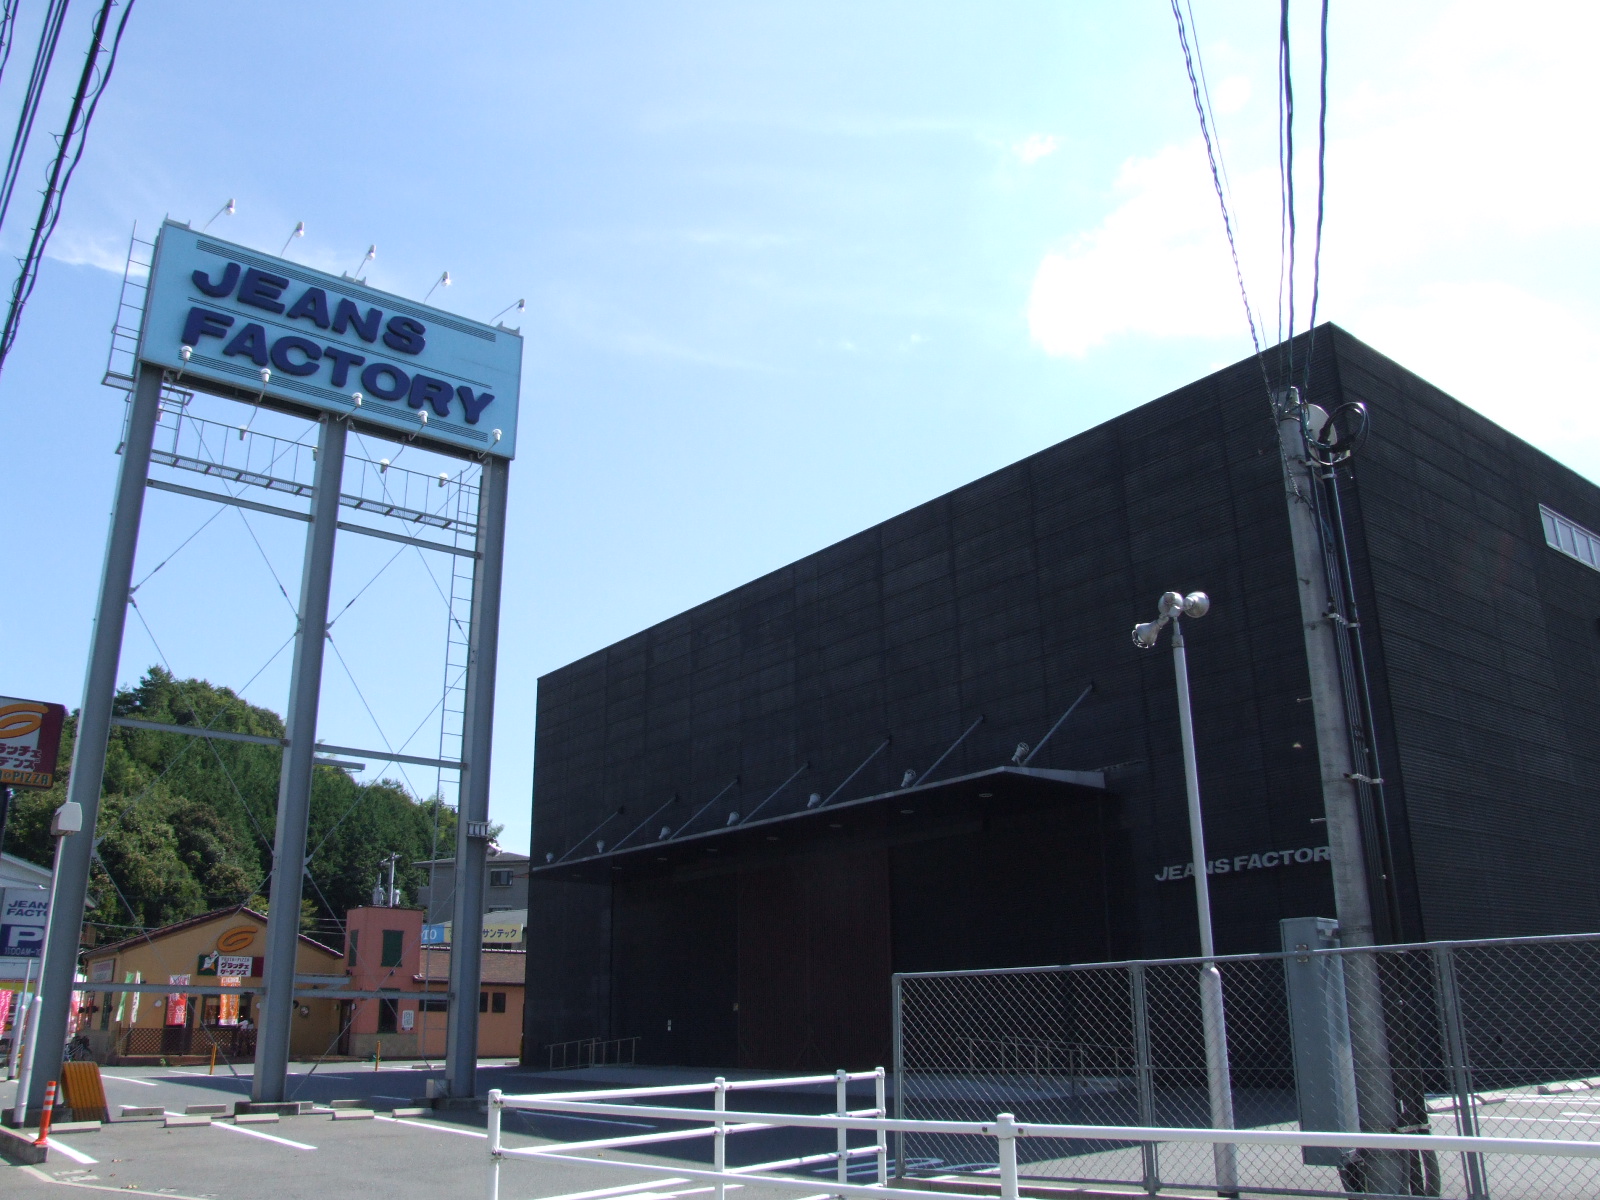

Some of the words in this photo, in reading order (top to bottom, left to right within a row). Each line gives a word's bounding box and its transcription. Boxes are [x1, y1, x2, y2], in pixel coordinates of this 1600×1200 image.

[191, 261, 427, 356] JEANS
[180, 306, 496, 425] FACTORY
[12, 770, 50, 785] PIZZA
[8, 926, 45, 947] P
[482, 928, 516, 938] サンテック
